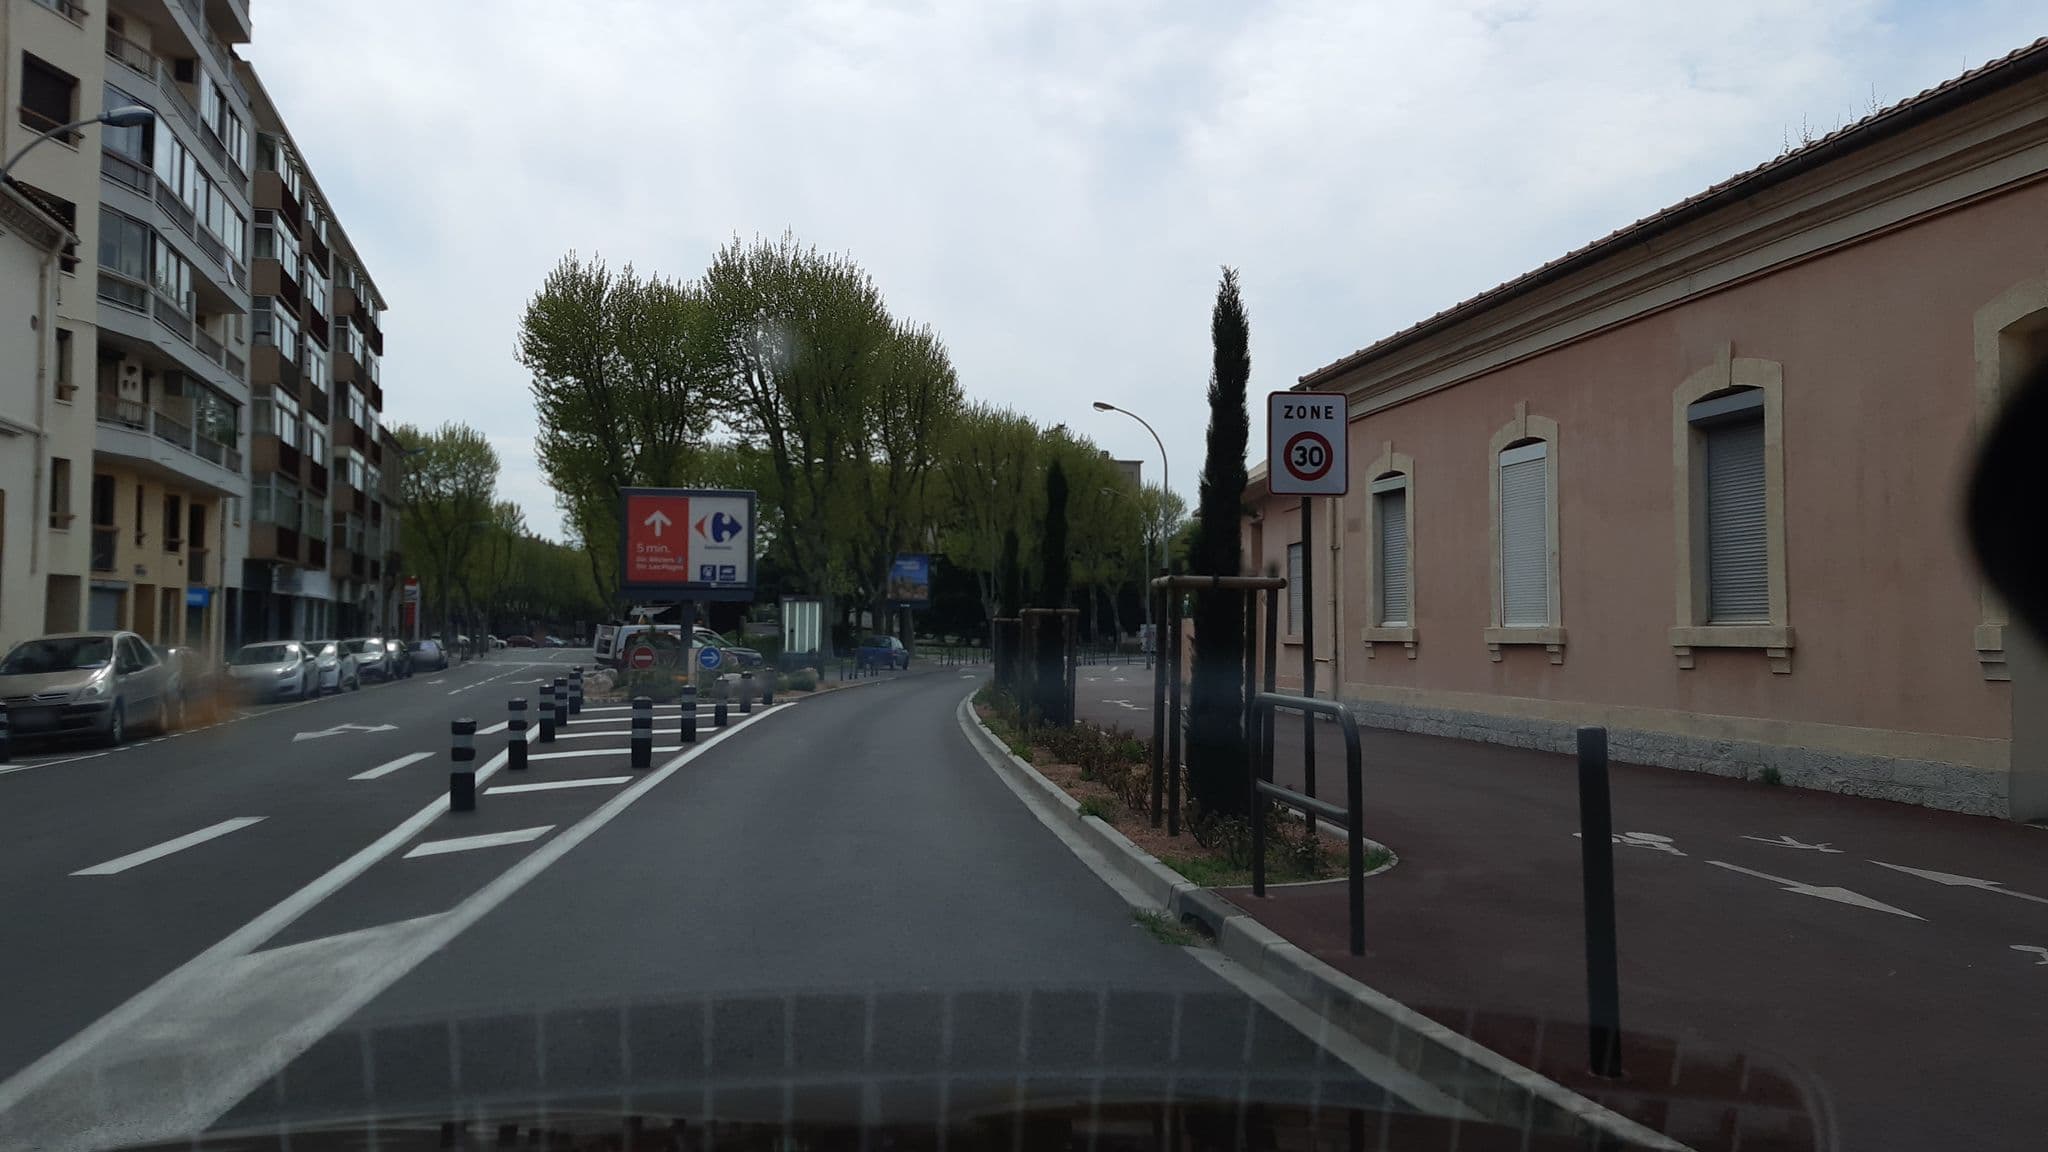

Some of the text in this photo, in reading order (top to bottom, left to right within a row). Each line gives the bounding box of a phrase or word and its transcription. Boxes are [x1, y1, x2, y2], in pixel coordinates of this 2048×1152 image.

[1284, 405, 1333, 419] ZONE
[1294, 446, 1323, 467] 30
[636, 543, 645, 552] 5
